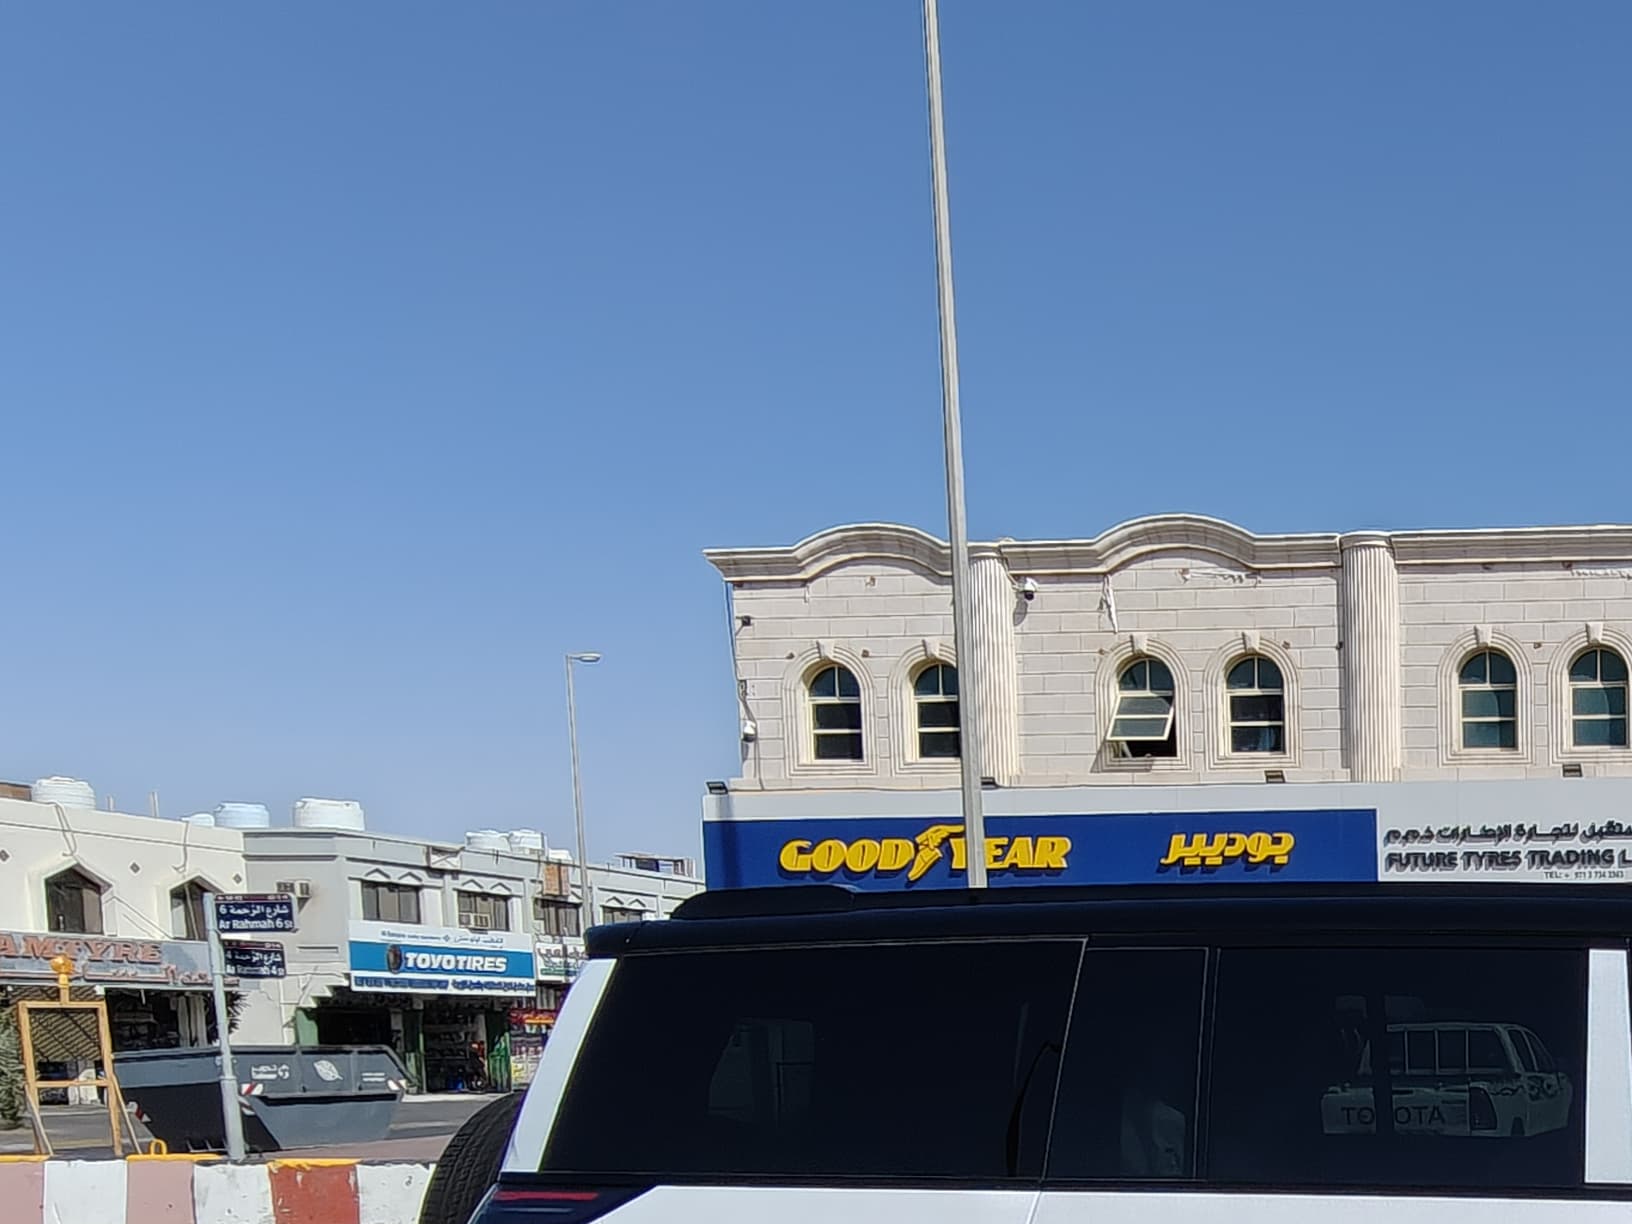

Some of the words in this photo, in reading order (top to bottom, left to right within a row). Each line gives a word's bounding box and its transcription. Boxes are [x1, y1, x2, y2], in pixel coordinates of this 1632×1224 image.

[1384, 851, 1459, 872] FUTURE
[1460, 850, 1522, 872] TYRES
[1524, 848, 1614, 870] TRADING
[276, 918, 284, 929] 6
[1341, 1106, 1446, 1125] TOOTA
